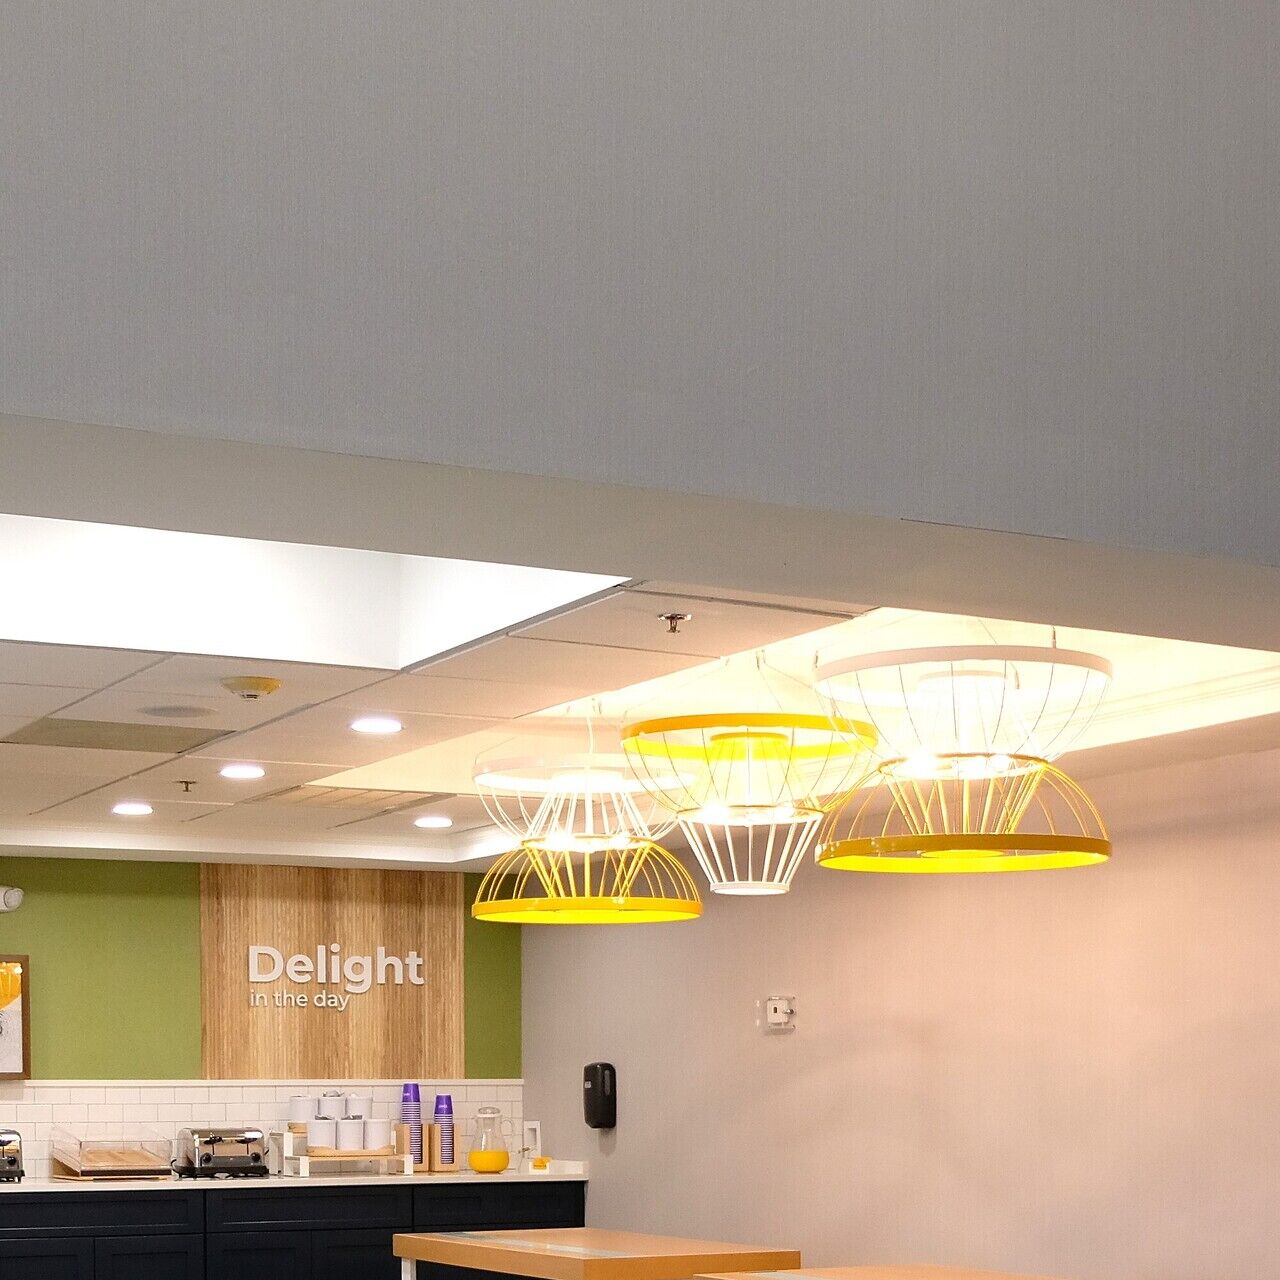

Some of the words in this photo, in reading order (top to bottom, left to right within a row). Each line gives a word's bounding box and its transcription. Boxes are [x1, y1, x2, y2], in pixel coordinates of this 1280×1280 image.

[248, 943, 425, 994] Delight
[250, 989, 268, 1008] in
[273, 990, 309, 1008] the
[314, 990, 351, 1012] day
